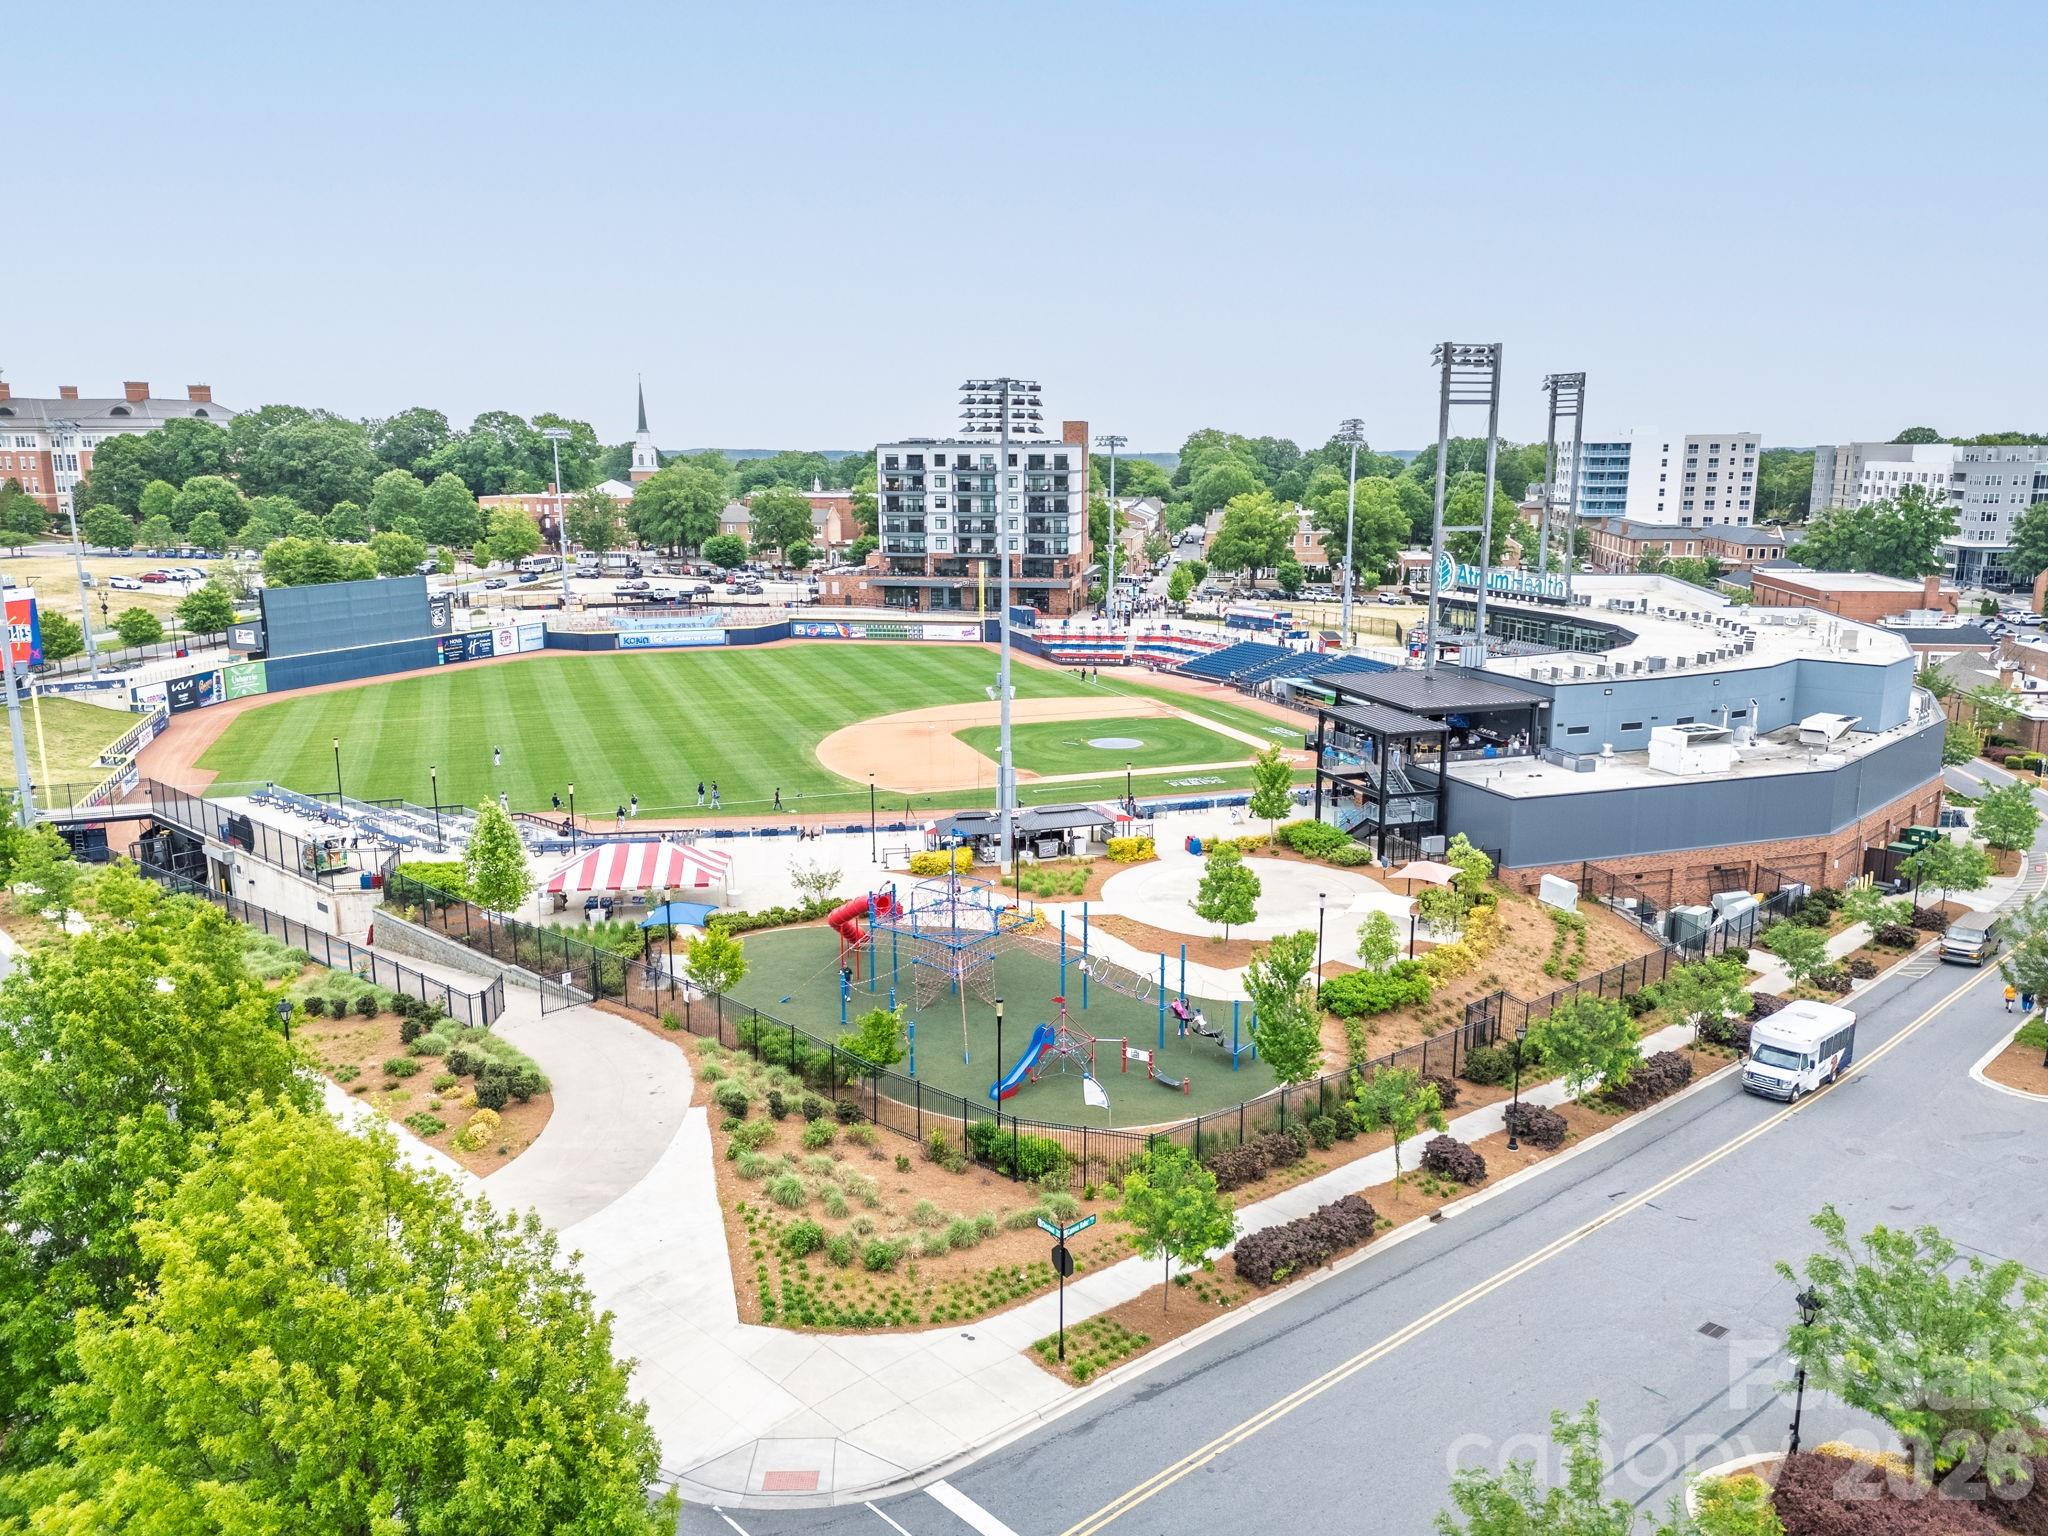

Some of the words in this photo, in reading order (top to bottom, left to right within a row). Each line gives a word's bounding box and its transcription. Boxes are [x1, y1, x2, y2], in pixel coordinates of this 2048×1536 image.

[1457, 563, 1510, 590] Atrum
[1512, 568, 1567, 598] Health
[623, 636, 650, 645] KONA
